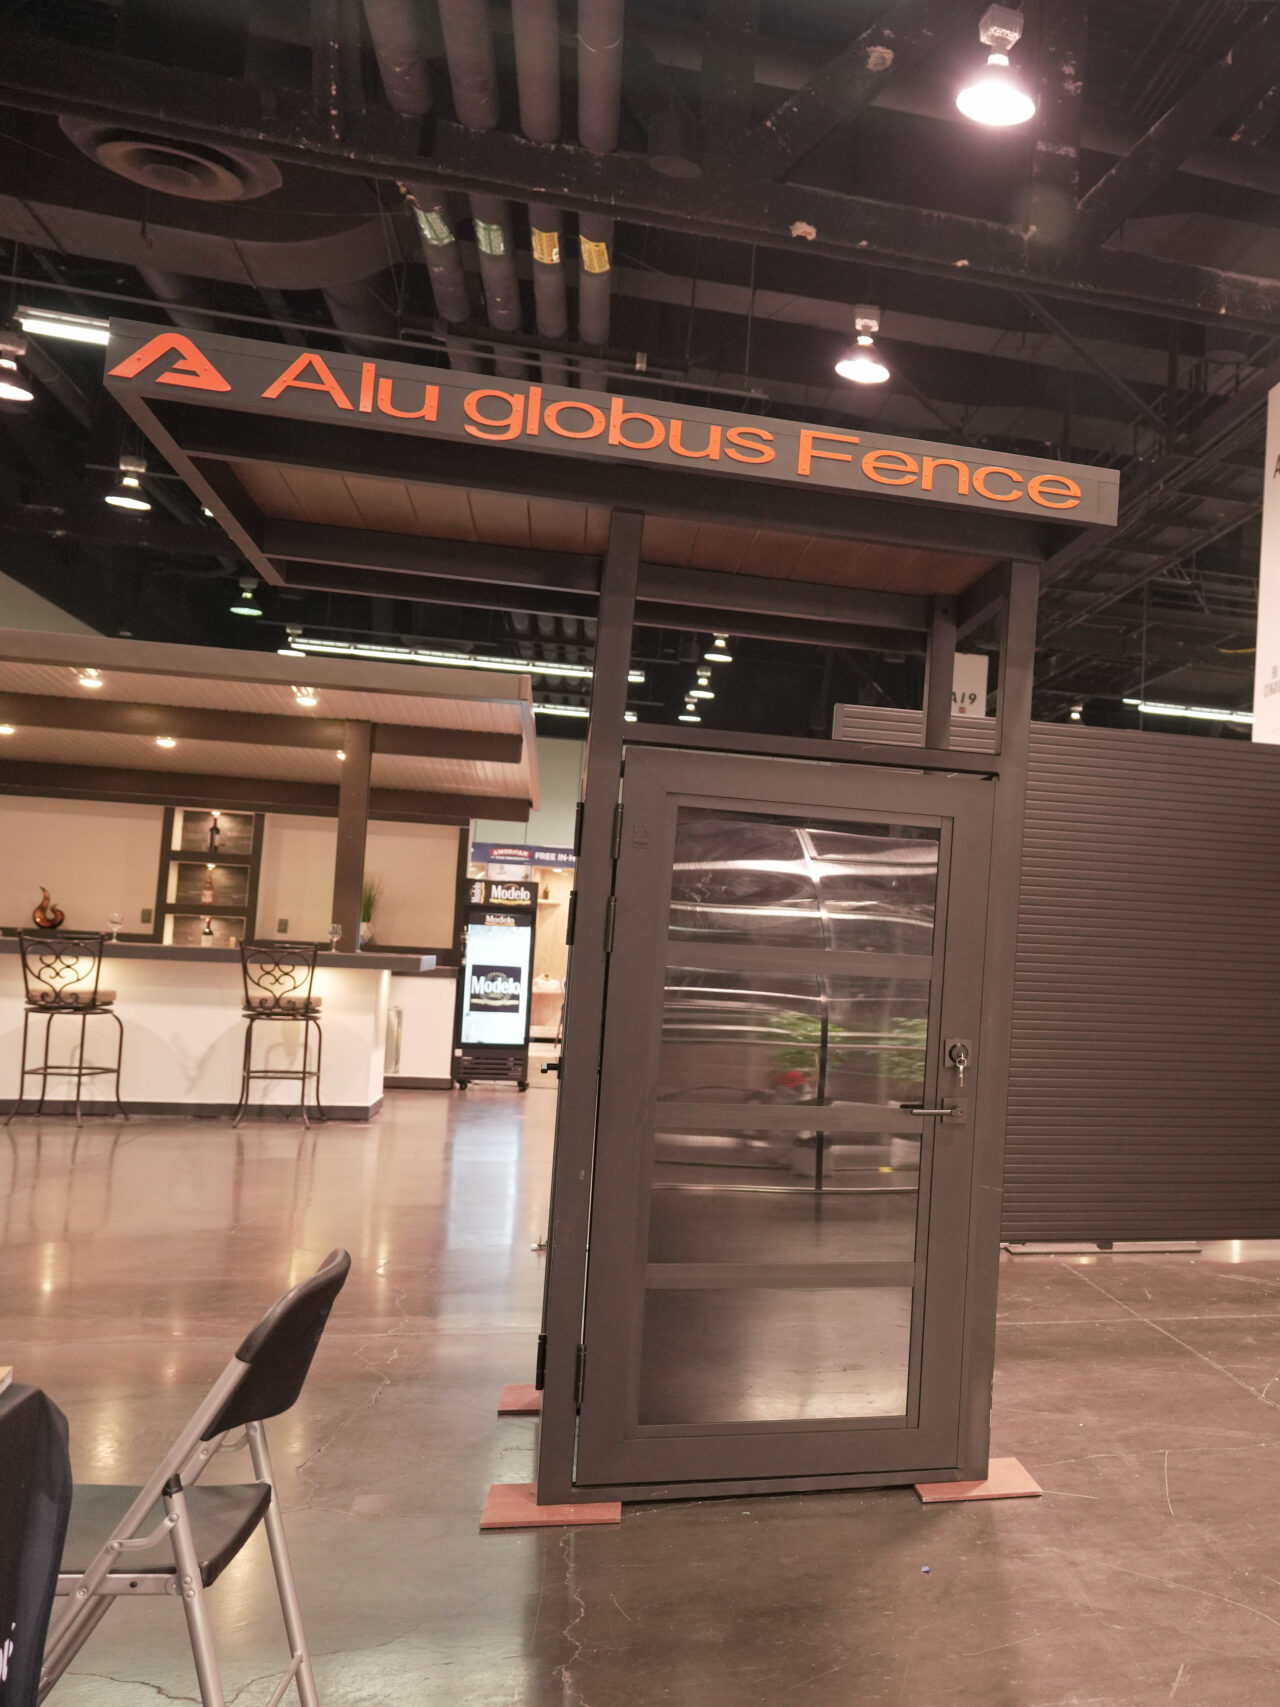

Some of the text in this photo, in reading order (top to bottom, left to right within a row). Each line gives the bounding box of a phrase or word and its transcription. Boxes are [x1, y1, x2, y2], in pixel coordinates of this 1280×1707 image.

[797, 429, 1082, 509] Fence
[535, 851, 556, 861] FREE
[491, 884, 531, 901] Modelo
[485, 914, 515, 924] Modelo
[471, 975, 521, 995] Modelo
